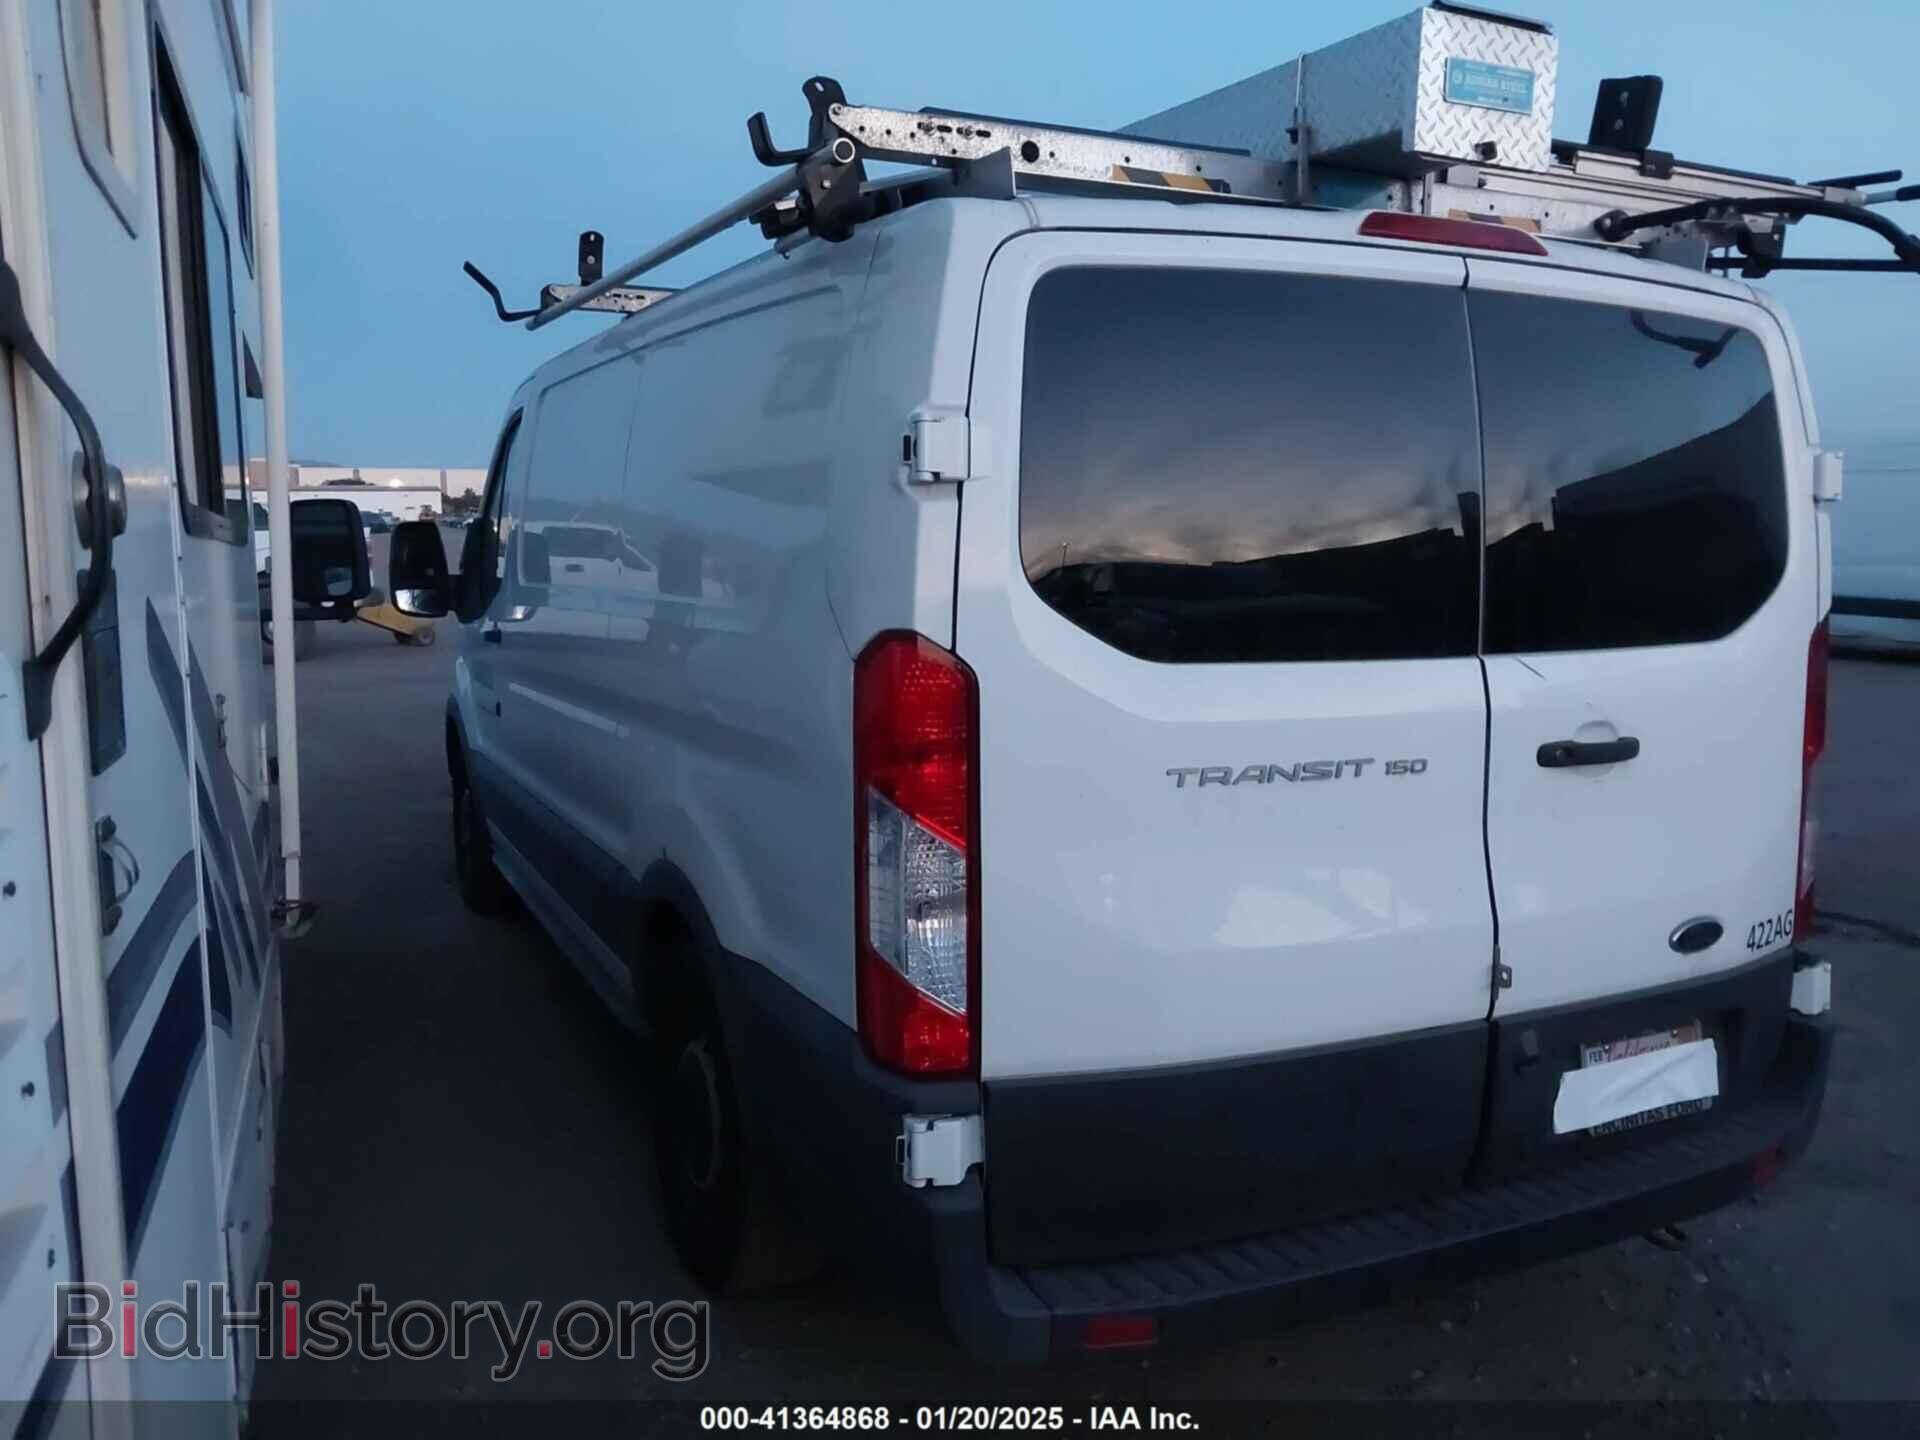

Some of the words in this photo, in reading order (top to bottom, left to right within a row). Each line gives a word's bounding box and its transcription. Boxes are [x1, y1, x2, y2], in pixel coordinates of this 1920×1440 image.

[1166, 757, 1375, 788] TRANSIT
[1384, 758, 1428, 776] 150
[1746, 908, 1793, 953] 422AG
